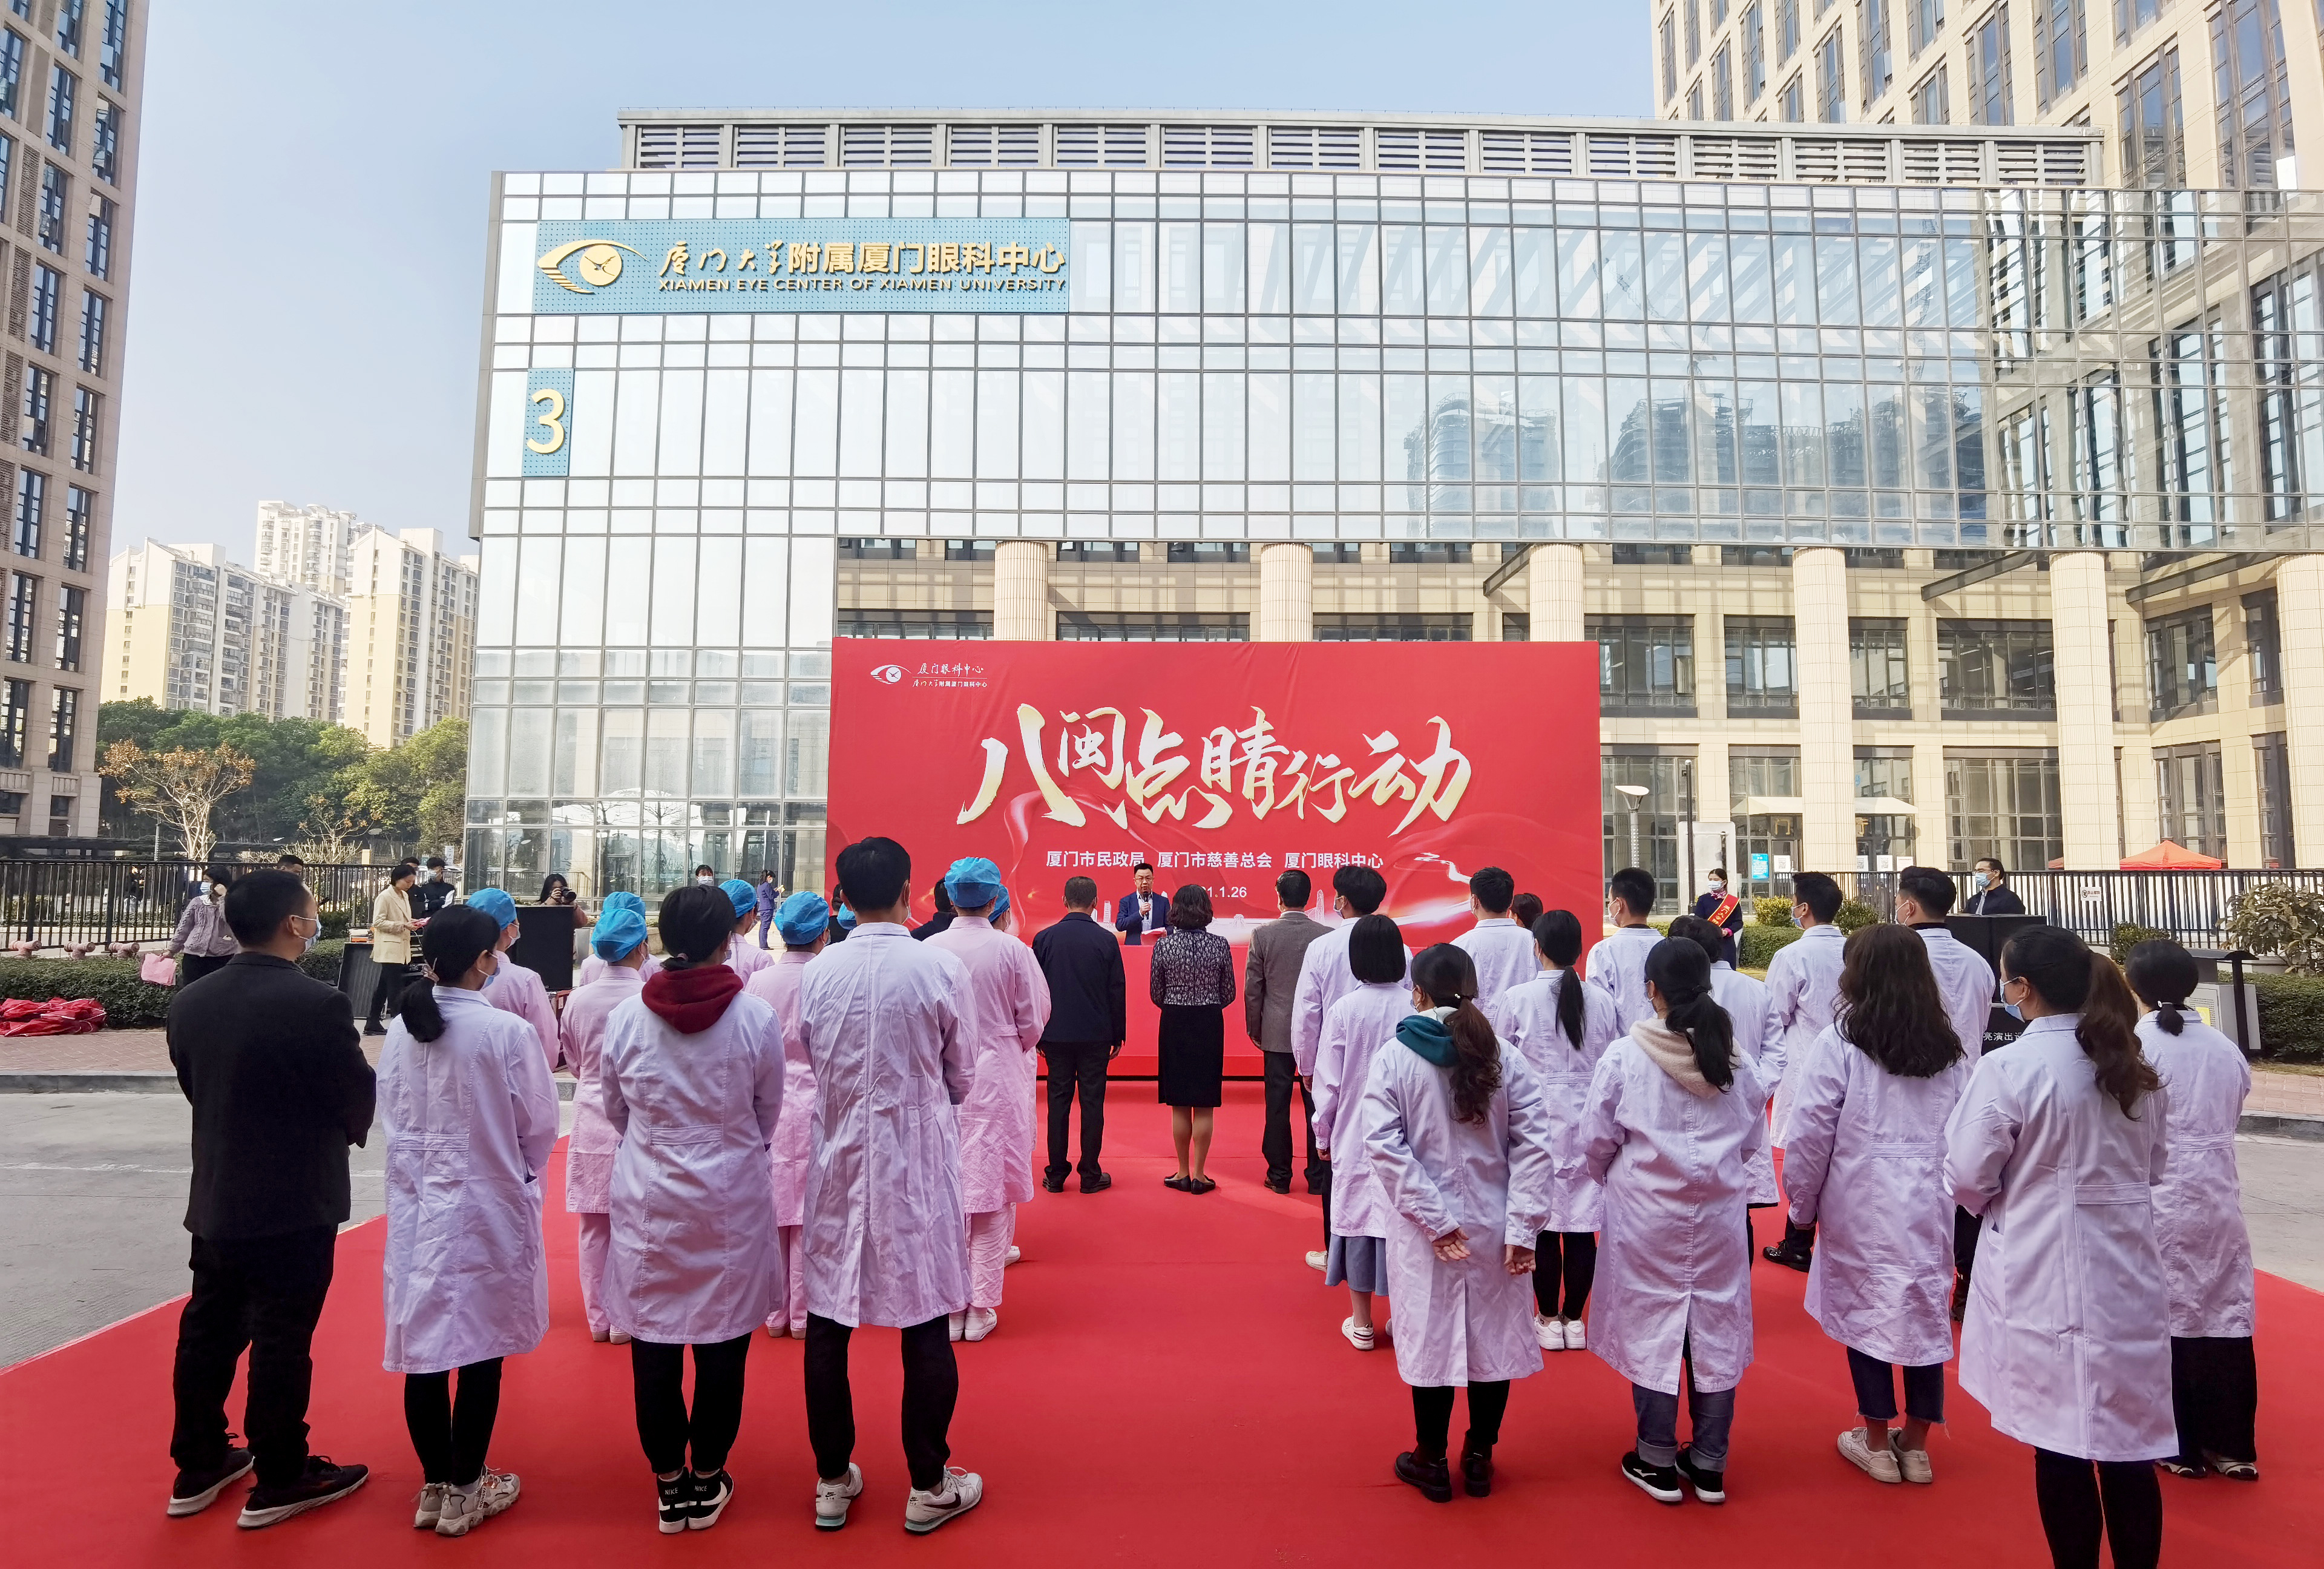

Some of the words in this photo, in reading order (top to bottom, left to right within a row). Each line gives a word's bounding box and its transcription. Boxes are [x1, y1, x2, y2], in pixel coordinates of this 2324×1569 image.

[659, 240, 1065, 276] 厦门大学附属厦门眼科中心
[659, 279, 730, 291] XIAMEN
[737, 279, 769, 291] EYE
[774, 279, 843, 291] CENTER
[850, 279, 875, 291] OF
[879, 279, 952, 291] XIAMEN
[959, 279, 1066, 291] UNIVERSITY
[527, 389, 565, 454] 3
[917, 663, 983, 677] 厦门眼科中心
[956, 702, 1472, 838] 八闽点睛行动
[1046, 850, 1144, 867] 厦门市民政局
[1157, 851, 1272, 867] 厦门市慈善总会
[1284, 852, 1384, 869] 厦门眼科中心
[1201, 886, 1247, 897] 1.1.26
